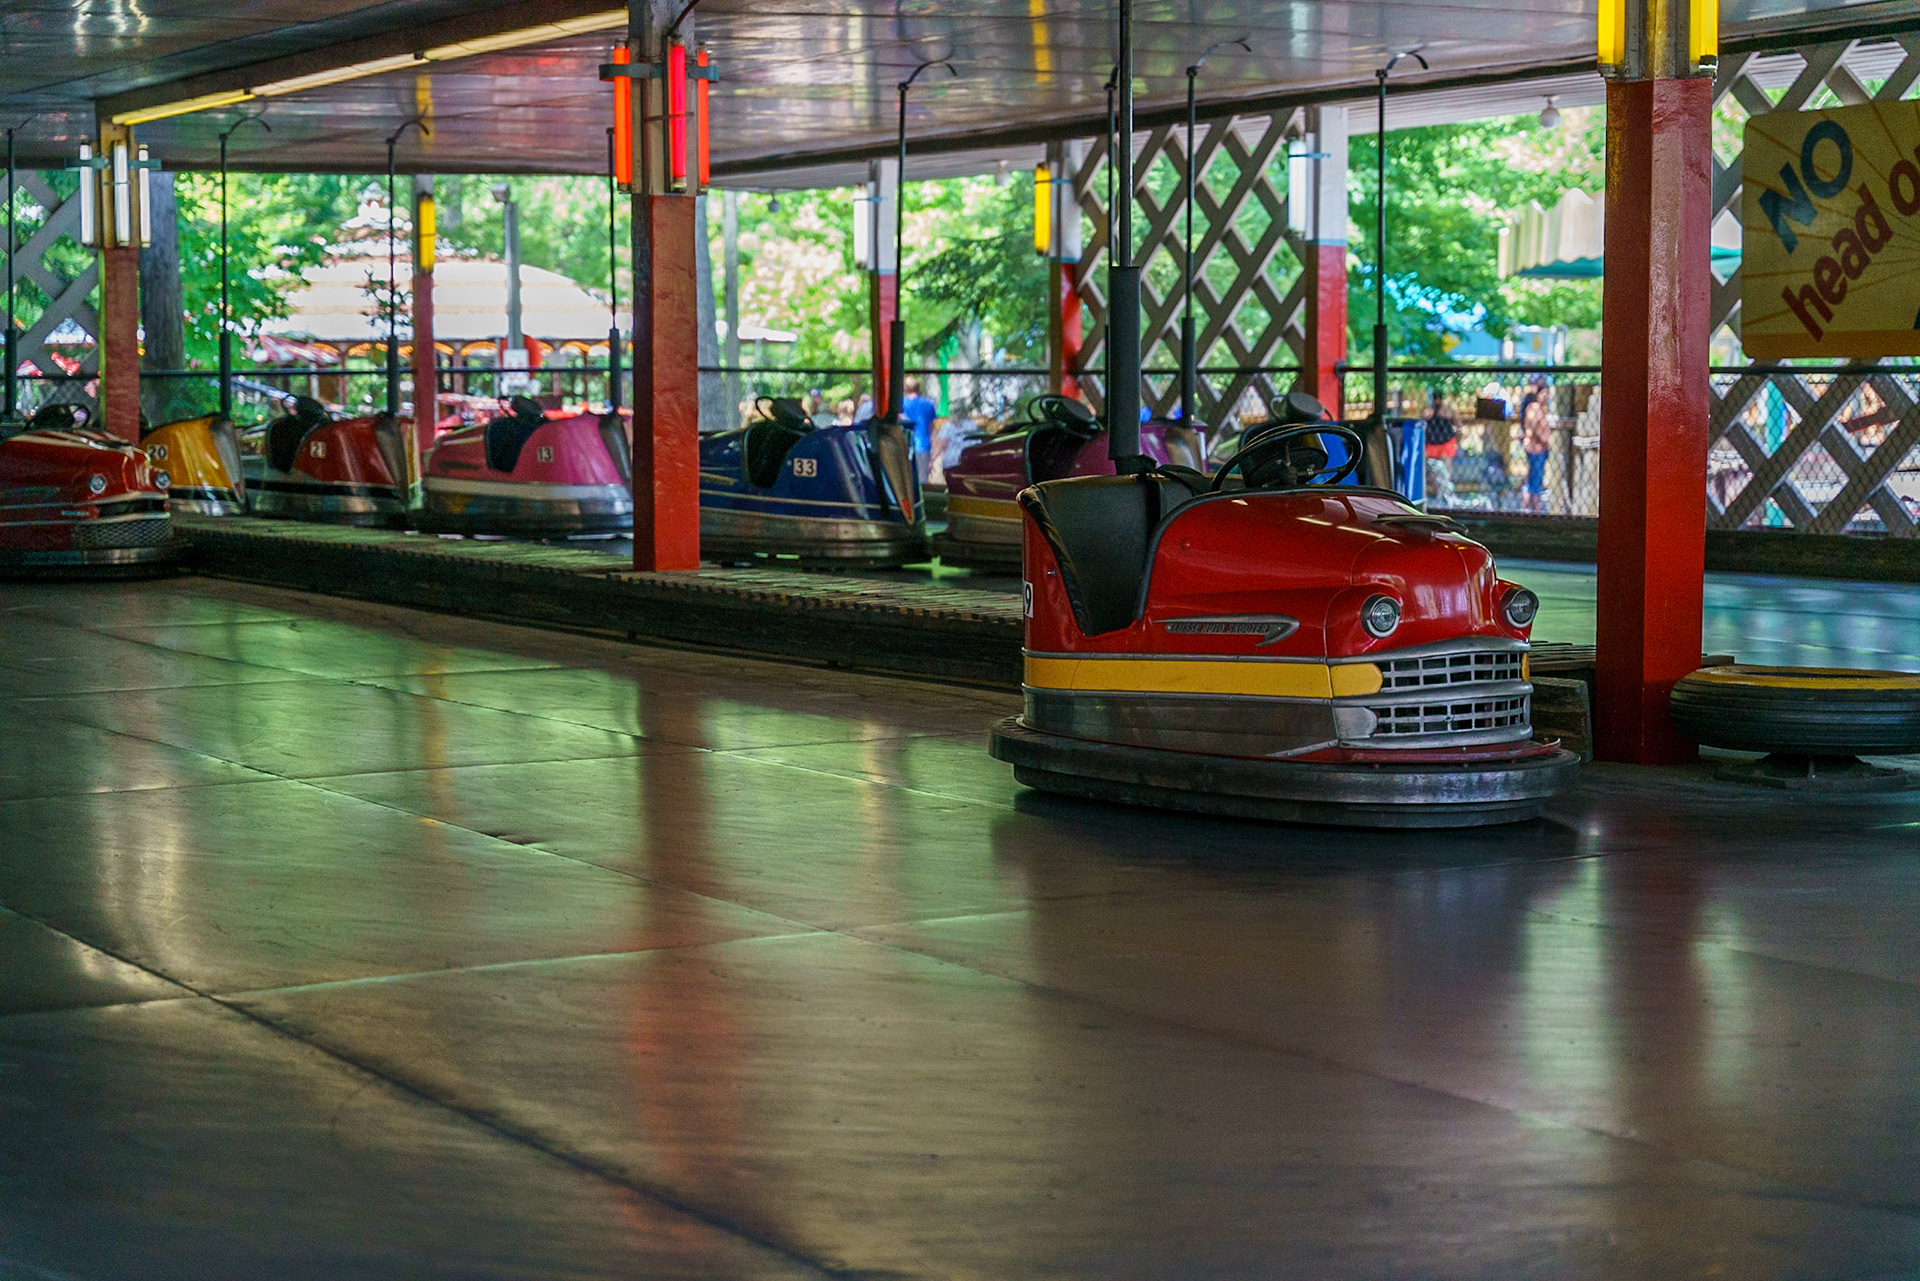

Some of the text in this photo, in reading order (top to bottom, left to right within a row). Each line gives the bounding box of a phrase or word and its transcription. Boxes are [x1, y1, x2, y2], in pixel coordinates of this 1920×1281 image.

[1758, 120, 1853, 254] NO
[1781, 143, 1920, 342] head o
[148, 445, 167, 459] 20
[539, 447, 552, 461] 13
[796, 459, 814, 475] 33
[1173, 623, 1268, 635] LUSSE AUTO SKOOTER
